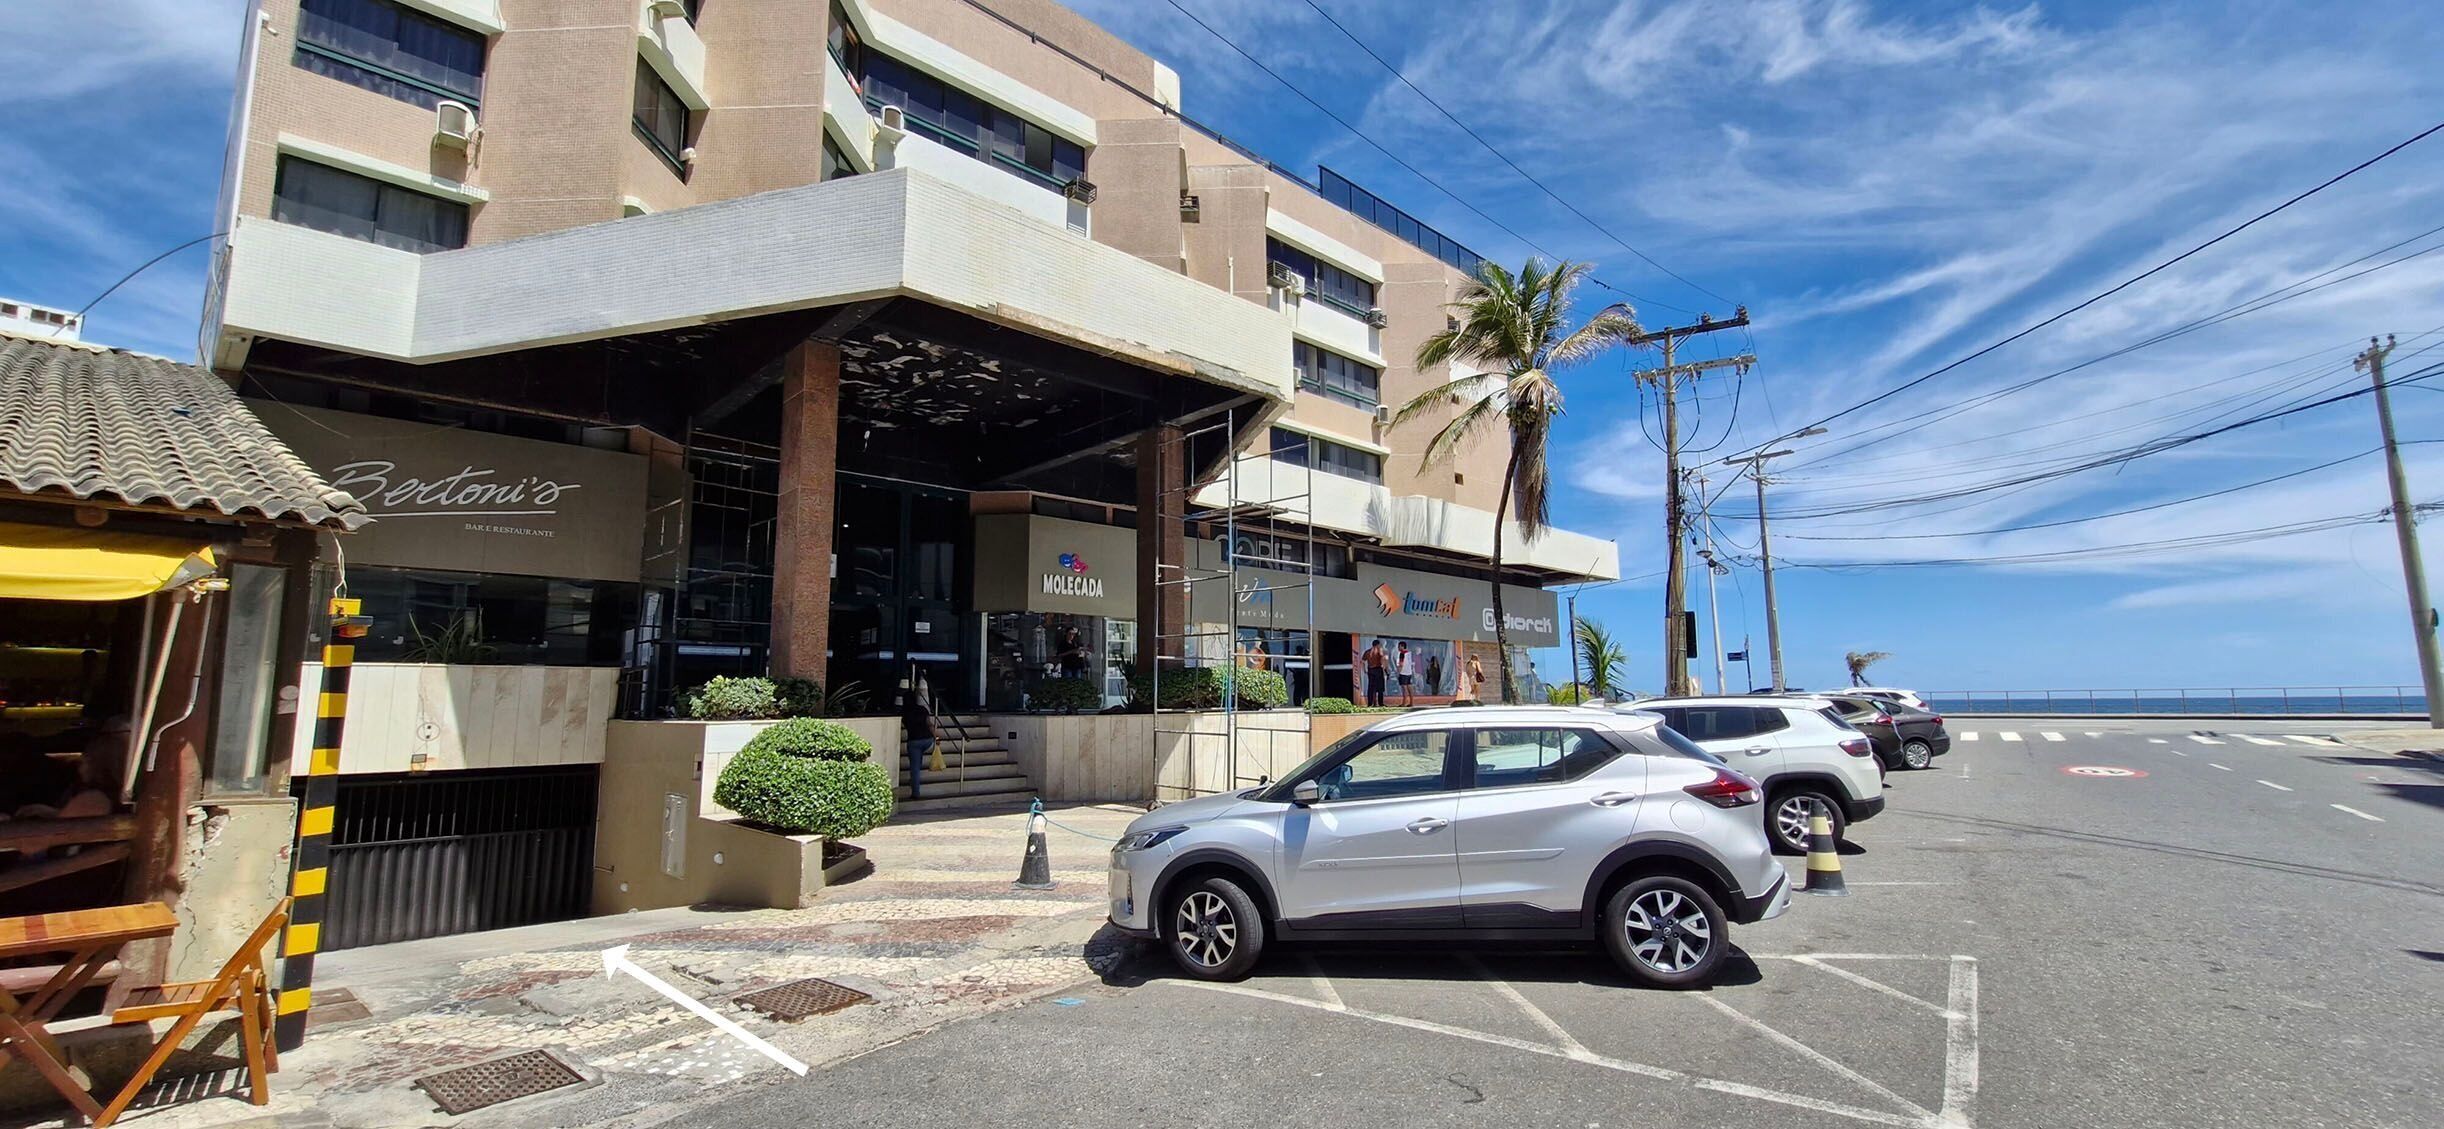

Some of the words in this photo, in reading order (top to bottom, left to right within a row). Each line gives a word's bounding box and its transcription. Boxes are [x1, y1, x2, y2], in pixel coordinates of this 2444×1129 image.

[331, 460, 582, 507] Bertoni's
[464, 523, 485, 532] BAR
[492, 525, 556, 538] RESTAURANTE
[1042, 573, 1104, 598] MOLECADA
